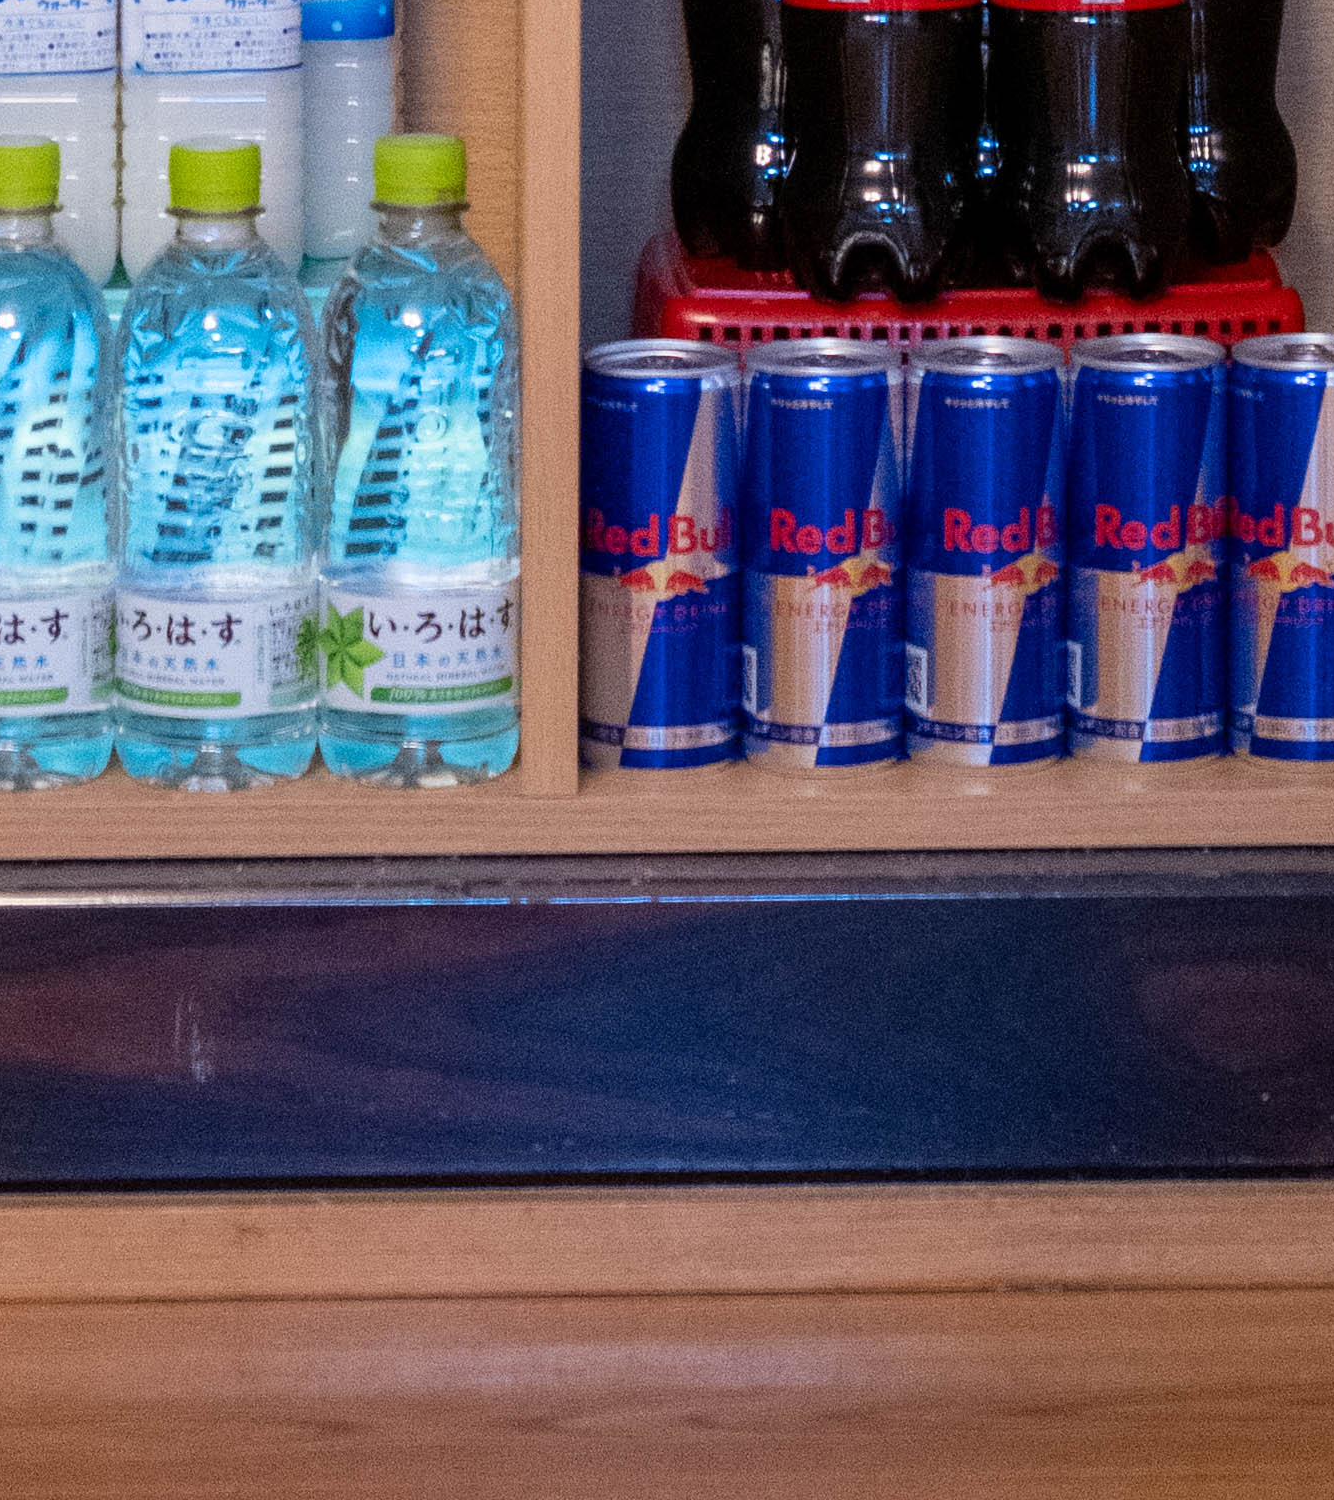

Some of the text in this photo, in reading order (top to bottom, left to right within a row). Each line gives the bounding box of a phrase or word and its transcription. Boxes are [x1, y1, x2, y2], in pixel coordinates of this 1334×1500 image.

[771, 508, 855, 554] Red
[944, 507, 1032, 553] Red
[1095, 503, 1180, 550] Red
